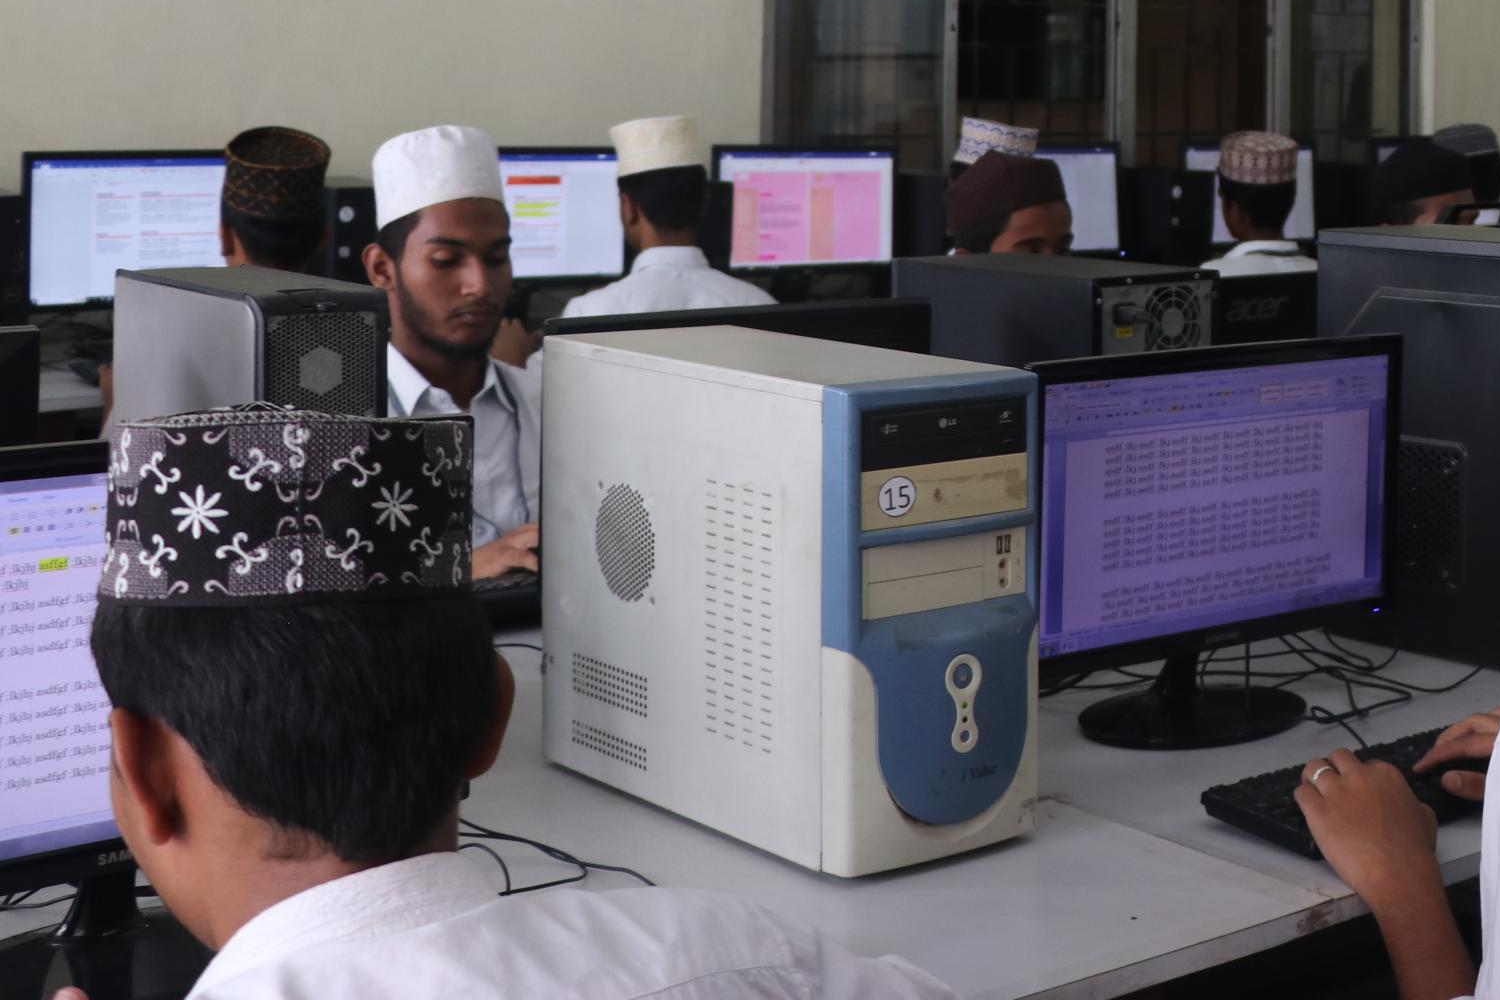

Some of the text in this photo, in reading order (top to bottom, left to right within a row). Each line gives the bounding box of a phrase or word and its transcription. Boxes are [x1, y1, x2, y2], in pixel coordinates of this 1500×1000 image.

[1226, 297, 1289, 322] acer
[883, 484, 912, 512] 15
[98, 849, 134, 866] SAM
